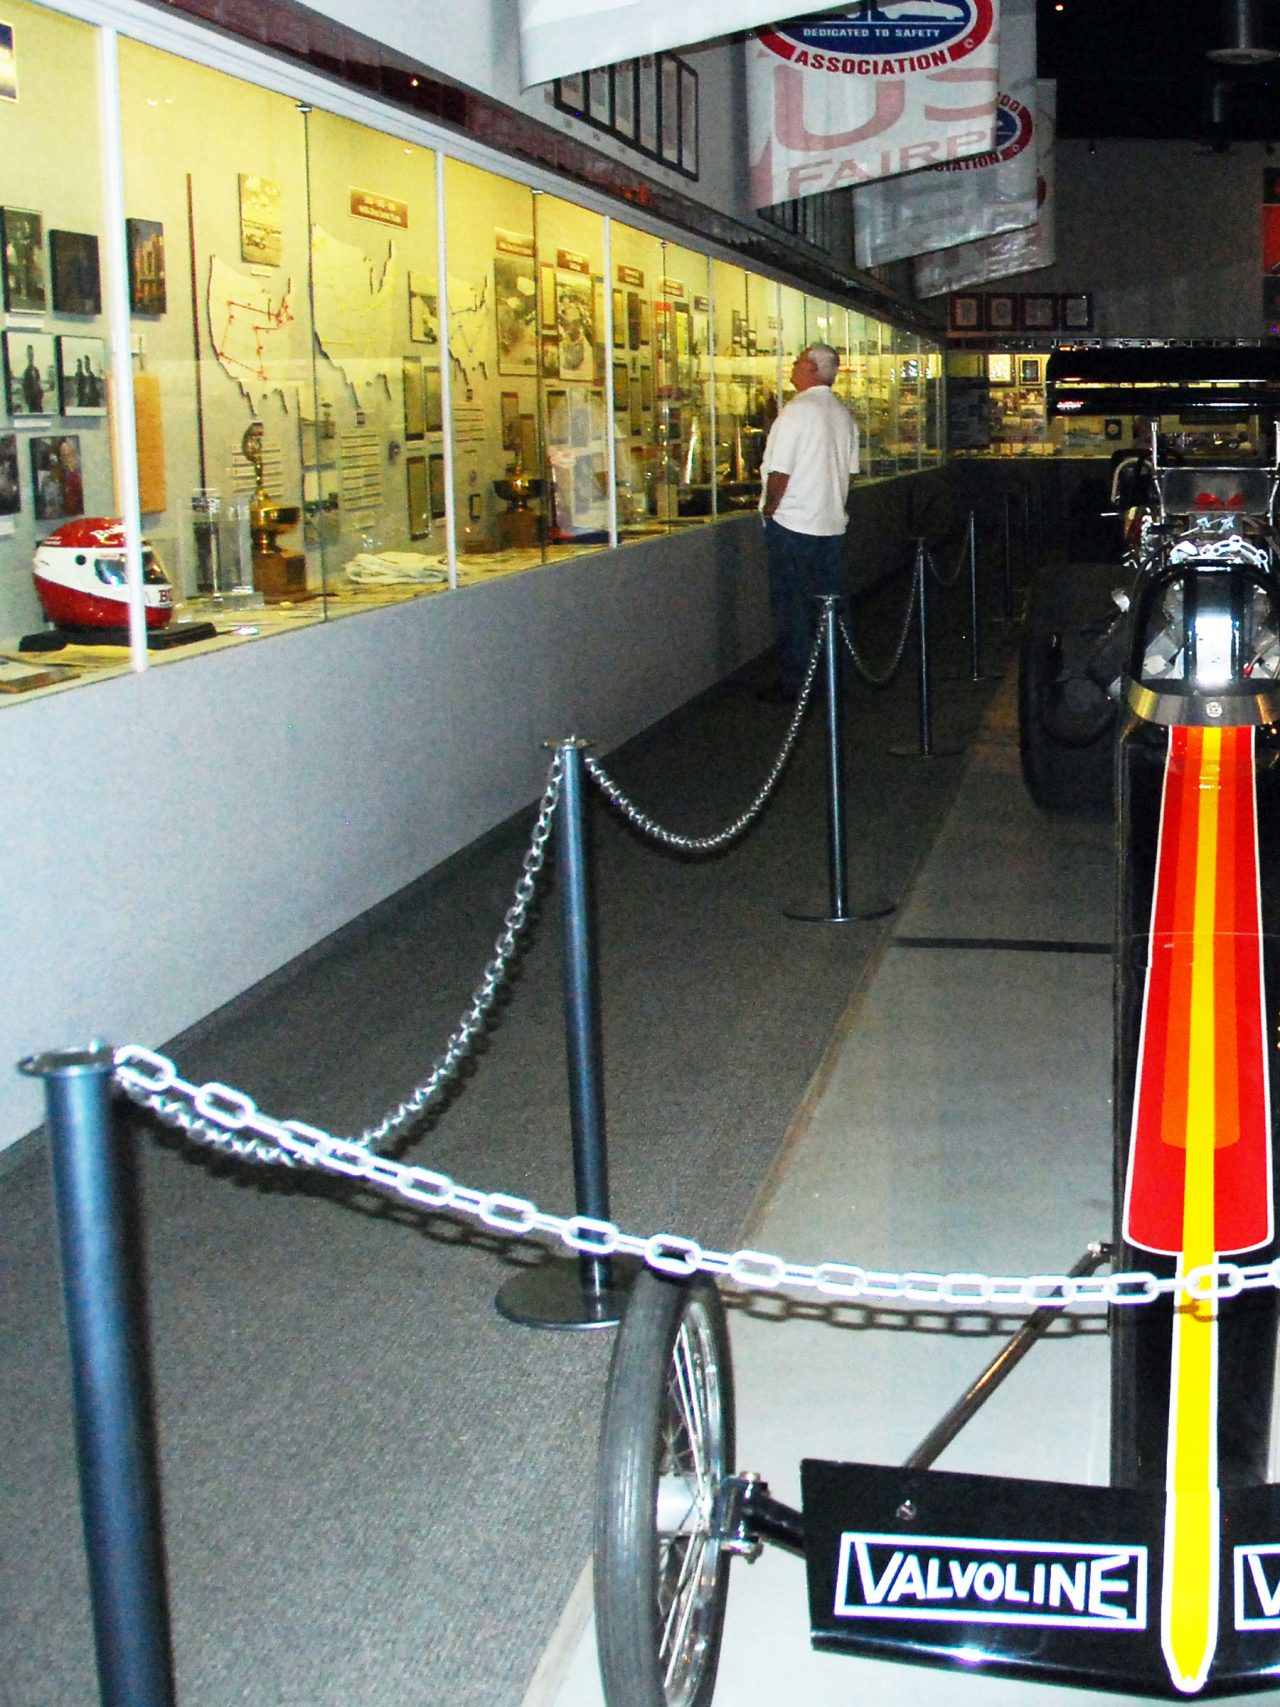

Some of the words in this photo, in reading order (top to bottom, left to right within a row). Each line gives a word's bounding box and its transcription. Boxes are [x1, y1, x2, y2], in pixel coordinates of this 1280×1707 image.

[803, 28, 869, 38] DEDICATED
[874, 28, 890, 37] TO
[895, 29, 941, 38] SAFETY
[794, 49, 949, 76] ASSOCIATION
[786, 128, 998, 200] FAIRP
[854, 1540, 1129, 1619] VALVOLINE
